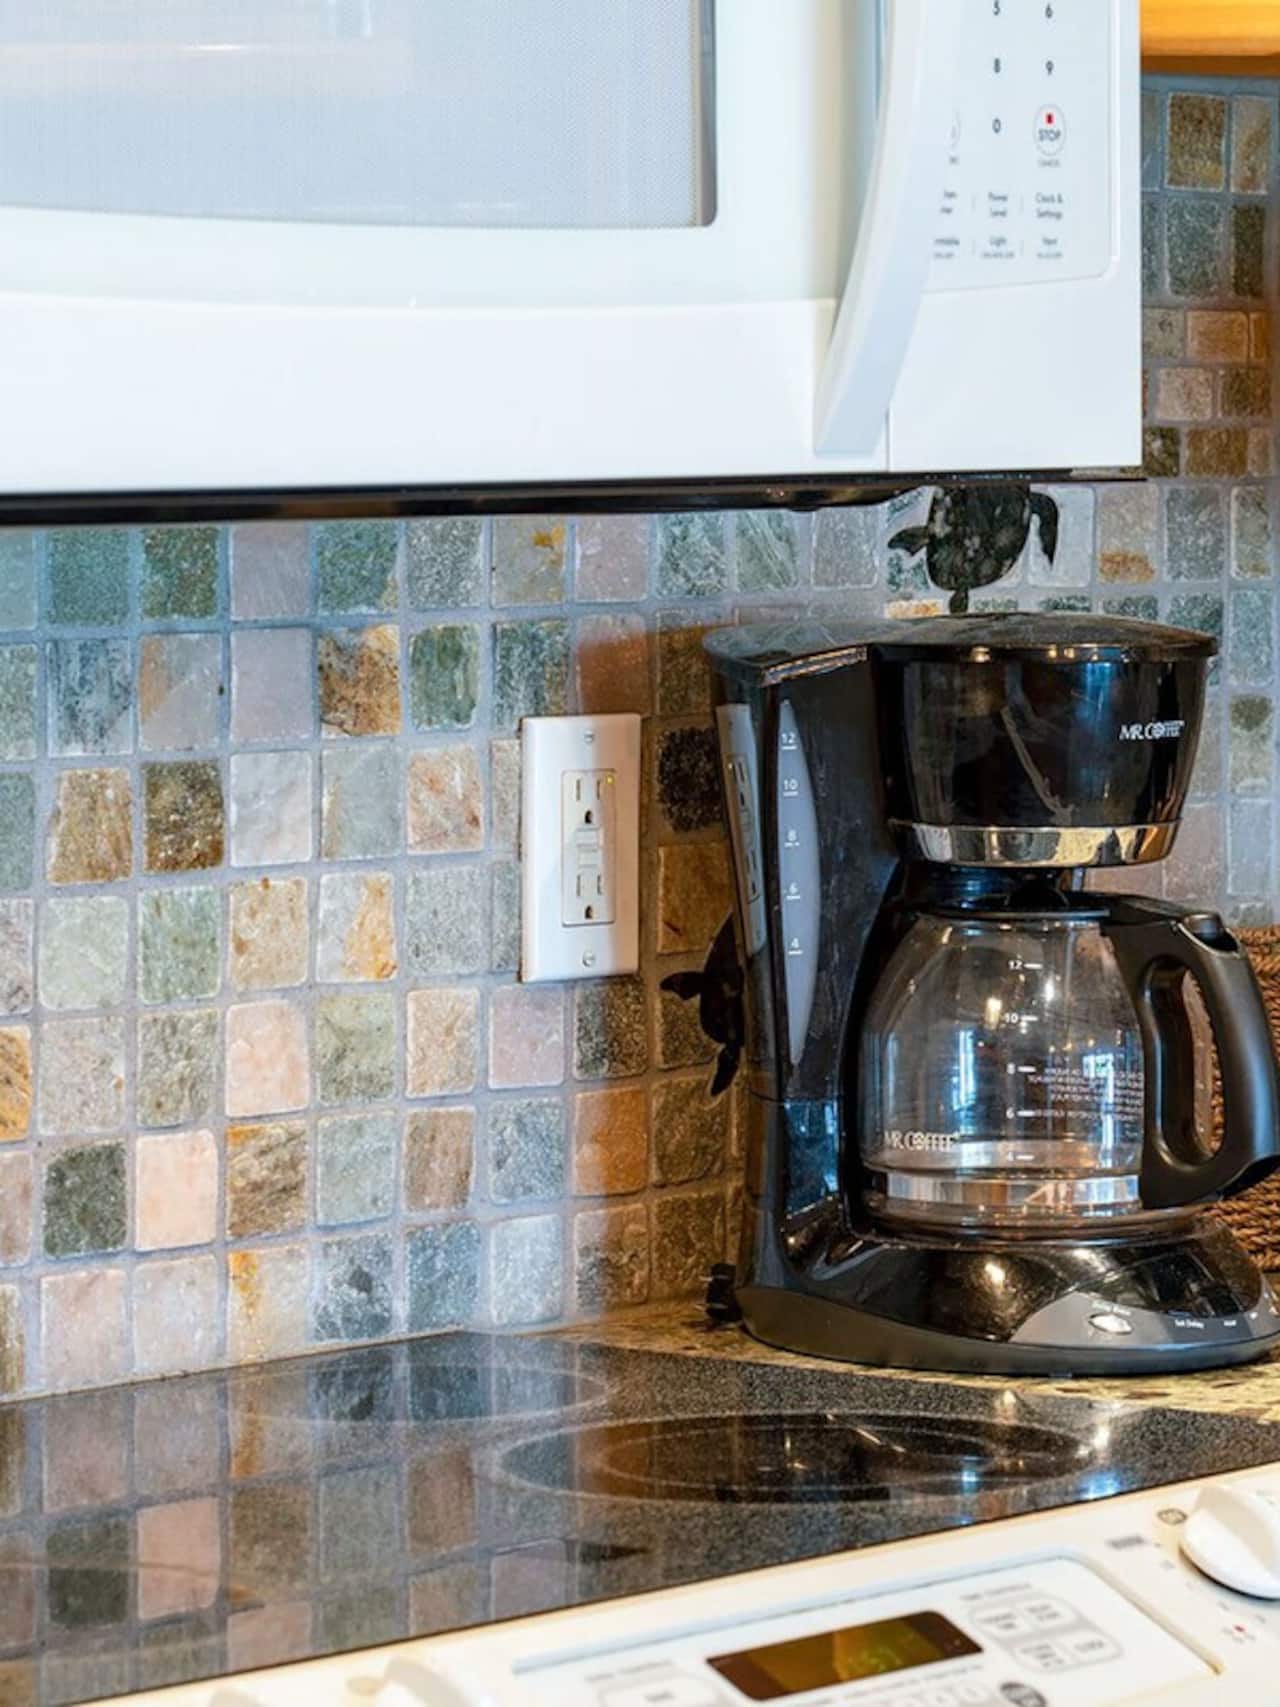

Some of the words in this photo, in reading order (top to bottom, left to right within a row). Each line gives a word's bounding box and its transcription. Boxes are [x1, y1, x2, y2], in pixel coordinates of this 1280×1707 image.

[1045, 3, 1054, 19] 6
[993, 57, 1001, 74] 8
[1045, 60, 1054, 75] 9
[1038, 128, 1062, 142] STOP
[781, 732, 796, 744] 12
[783, 779, 799, 791] 10
[787, 829, 797, 842] 8
[789, 882, 798, 894] 6
[791, 937, 800, 949] 4
[1008, 959, 1023, 970] 12
[1005, 1012, 1019, 1024] 10
[1006, 1063, 1016, 1075] 8
[1006, 1107, 1015, 1119] 6
